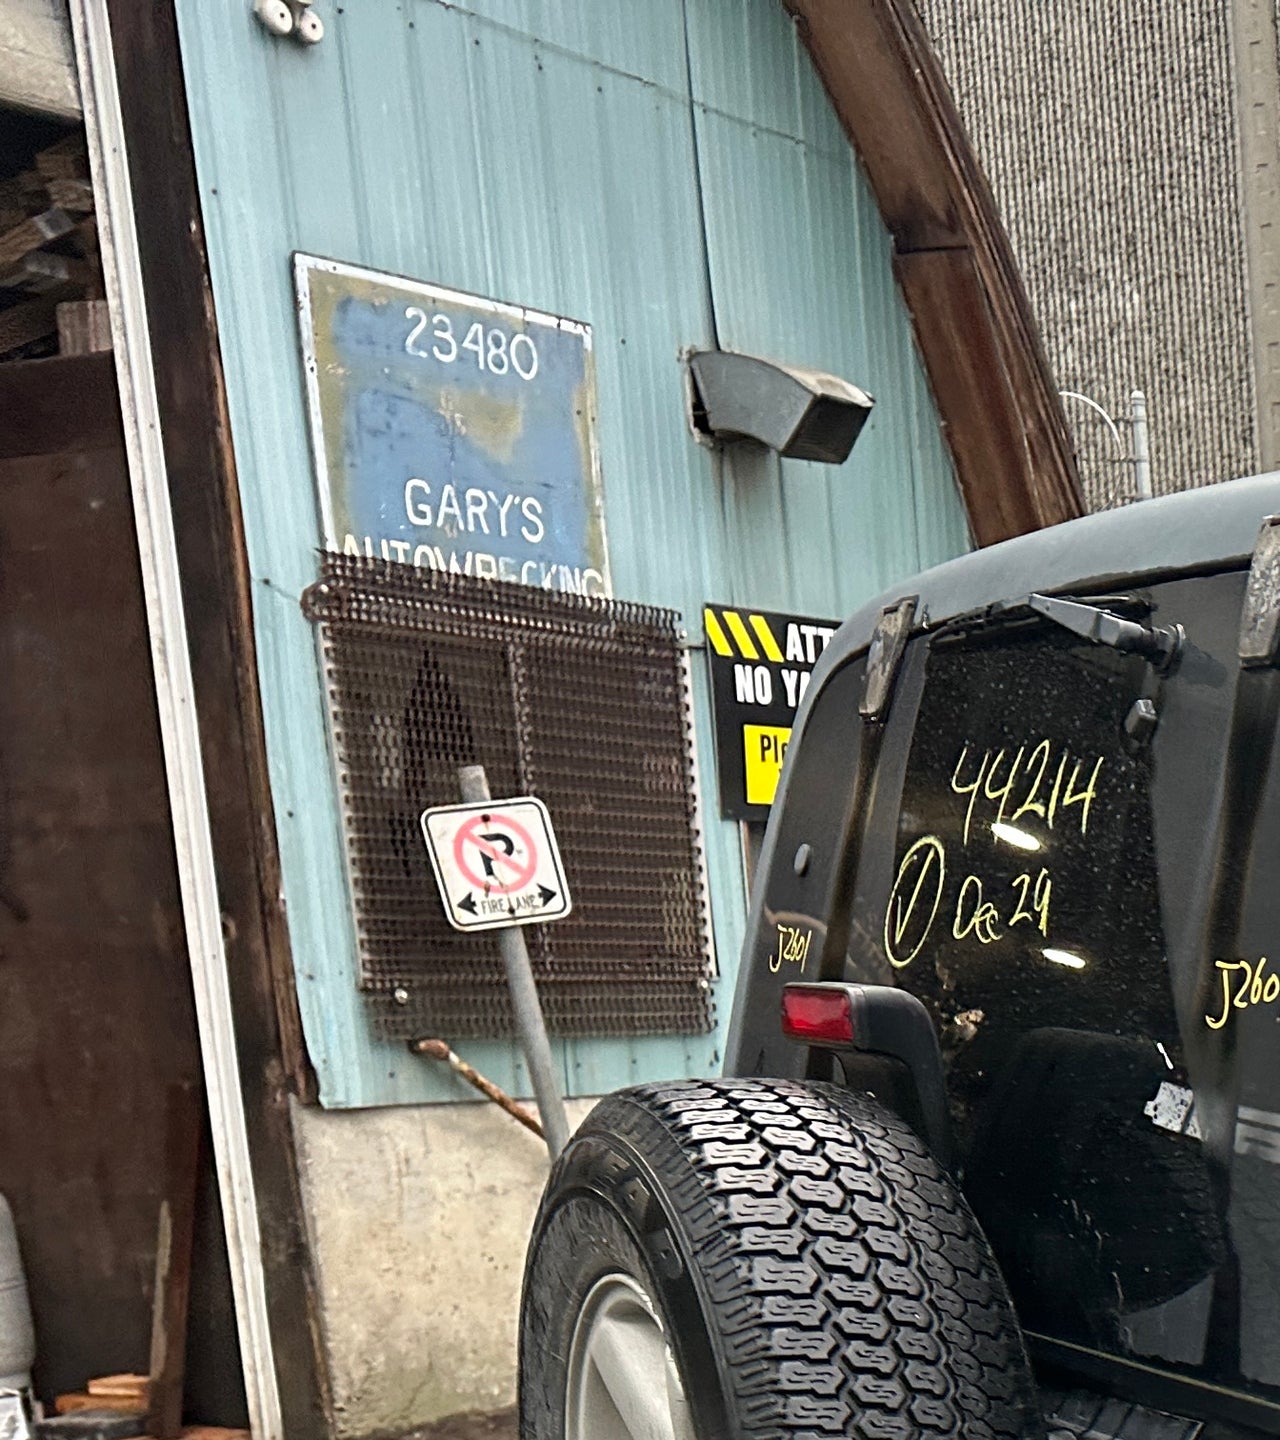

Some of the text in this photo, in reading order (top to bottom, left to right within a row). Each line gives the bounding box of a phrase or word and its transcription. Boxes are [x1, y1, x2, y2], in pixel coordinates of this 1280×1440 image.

[405, 306, 540, 381] 23480
[405, 478, 545, 544] GARY'S
[786, 622, 838, 664] ATT
[734, 664, 773, 706] NO
[951, 739, 1103, 846] 44214
[480, 894, 537, 915] FIRE ANE
[768, 923, 813, 973] J2601
